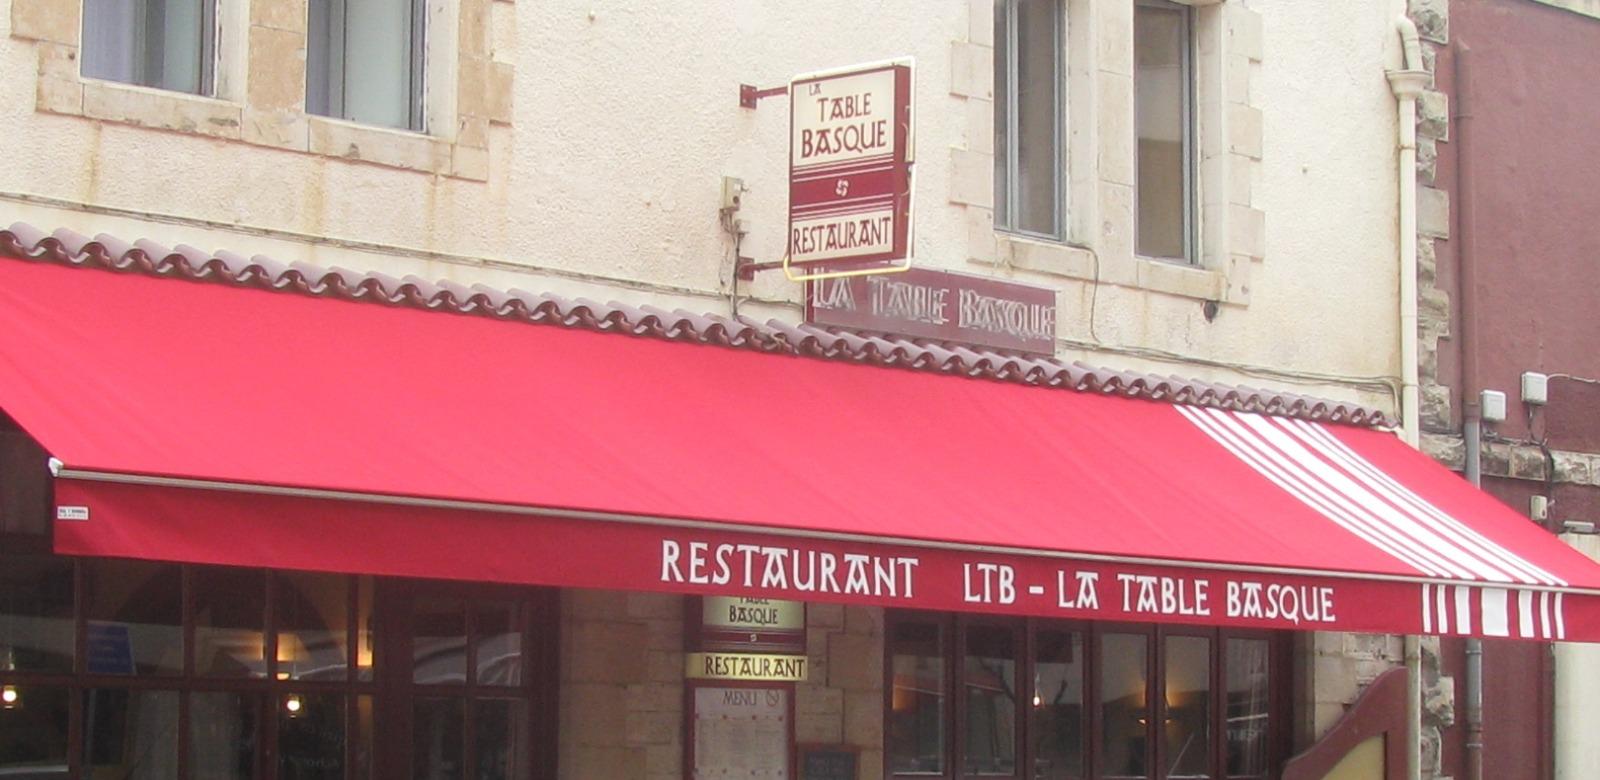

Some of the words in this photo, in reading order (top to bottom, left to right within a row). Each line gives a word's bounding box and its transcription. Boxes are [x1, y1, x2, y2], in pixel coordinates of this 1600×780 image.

[809, 83, 821, 96] LA
[817, 93, 872, 122] TABLE
[801, 120, 887, 159] BASQUE
[792, 217, 891, 255] RESTAURANT
[812, 267, 856, 311] LA
[866, 275, 950, 325] TABLE
[958, 288, 1056, 341] BASQUE
[660, 539, 919, 598] RESTAURANT
[962, 563, 1016, 604] LTB
[1057, 570, 1099, 610] LA
[1117, 573, 1211, 616] TABLE
[1226, 580, 1336, 625] BASQUE
[729, 605, 779, 625] BASQUE
[705, 656, 805, 678] RESTAURANT
[723, 690, 757, 706] MENU
